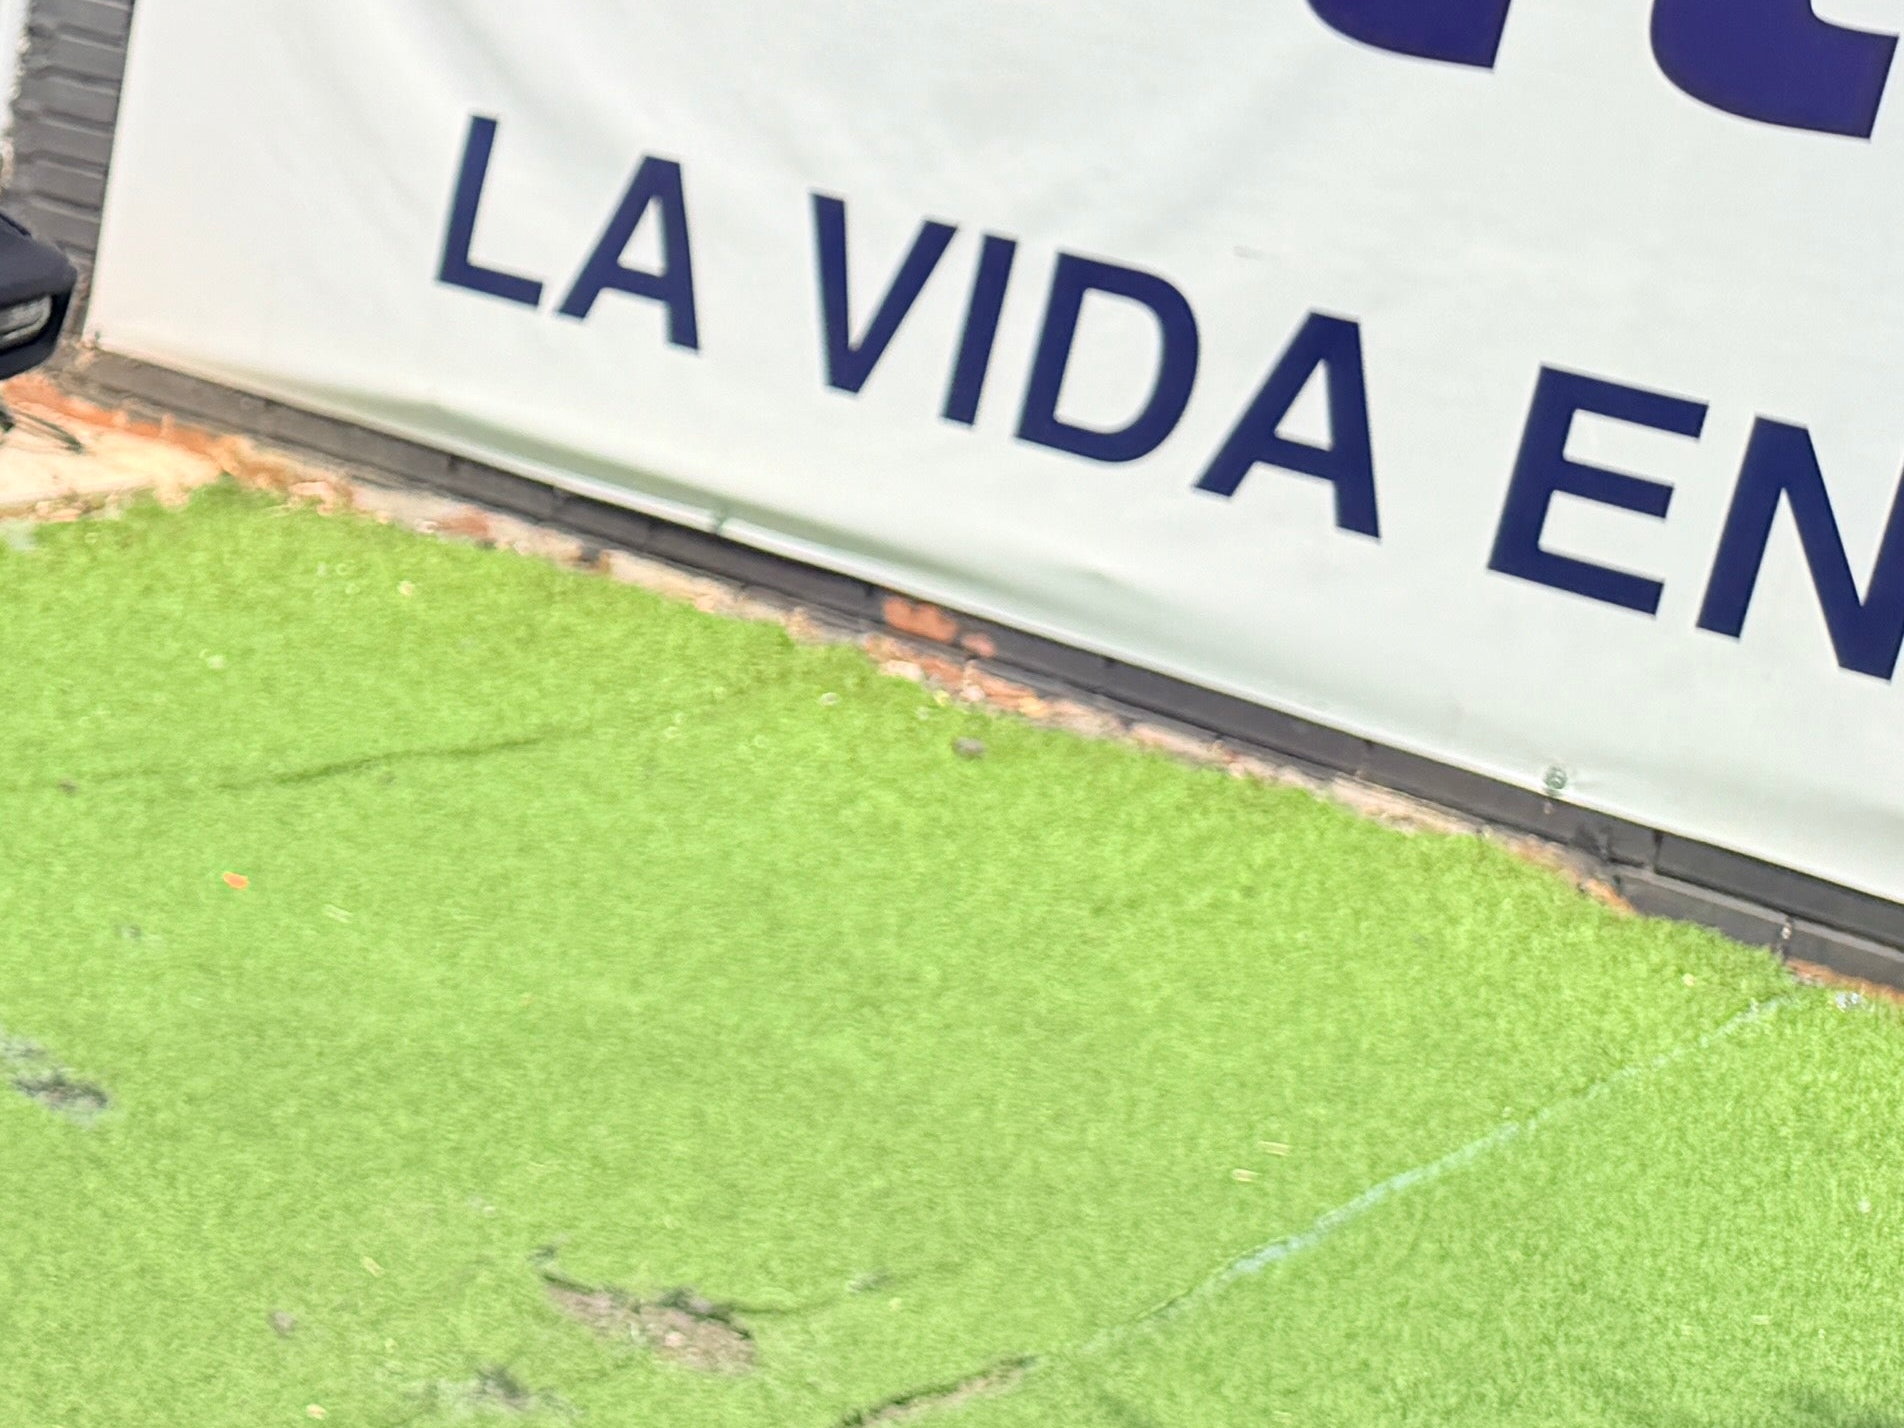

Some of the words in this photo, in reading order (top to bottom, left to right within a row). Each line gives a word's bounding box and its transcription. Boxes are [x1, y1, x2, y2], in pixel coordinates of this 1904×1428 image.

[435, 113, 701, 352] LA
[810, 191, 1381, 540] VIDA
[1486, 363, 1904, 682] EN
